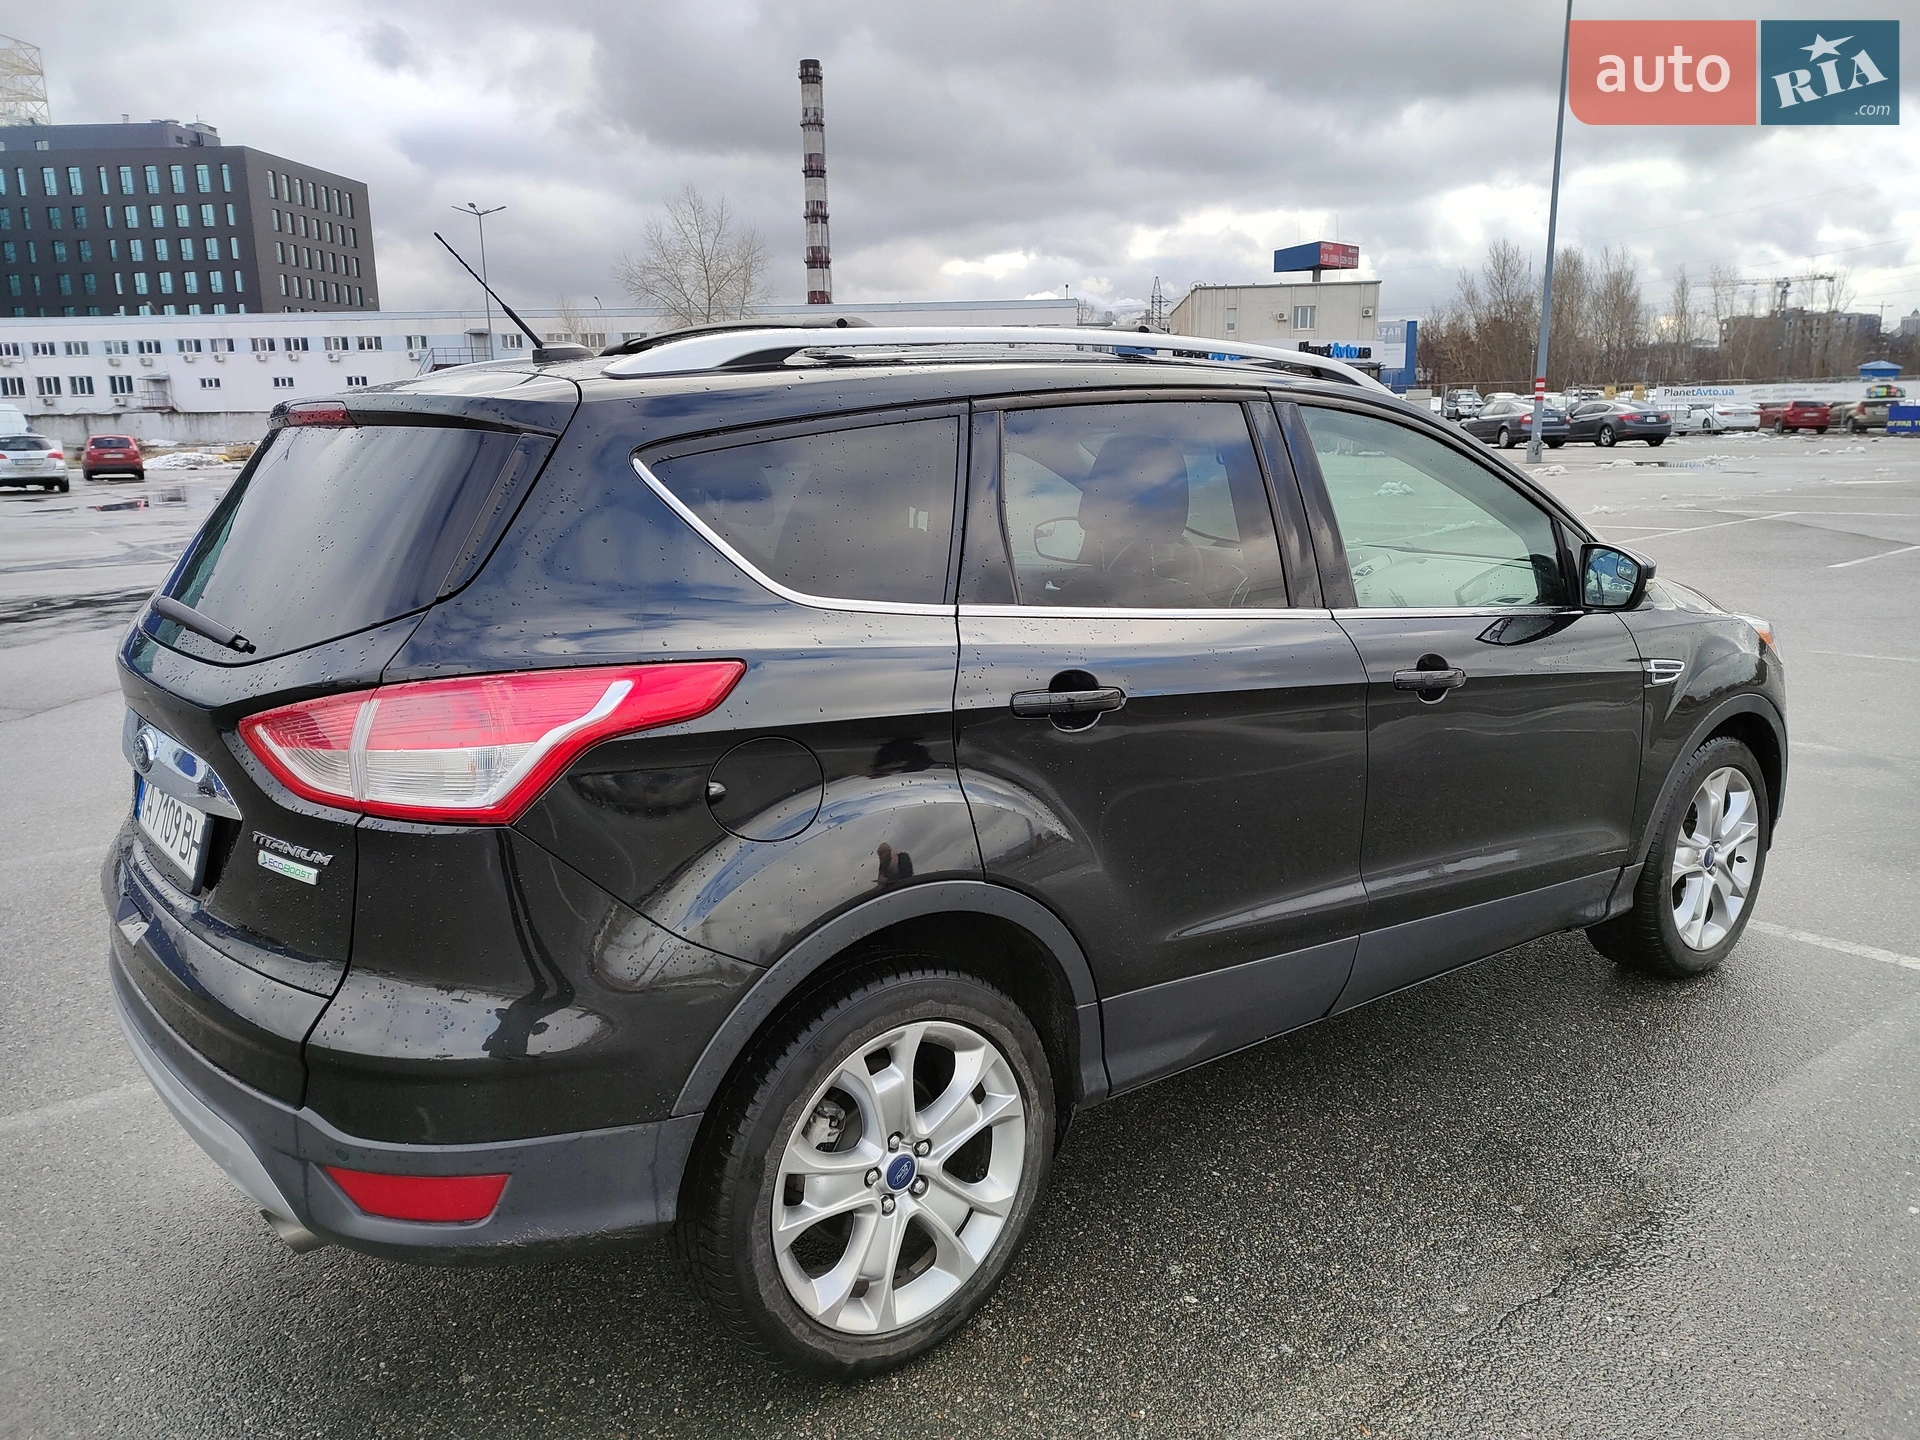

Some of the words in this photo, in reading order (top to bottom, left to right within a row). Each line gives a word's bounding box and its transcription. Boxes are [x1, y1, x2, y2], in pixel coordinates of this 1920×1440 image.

[1664, 387, 1735, 396] PlanetAvto.ua
[153, 788, 182, 849] 7109
[252, 830, 335, 866] TITANIUM
[268, 858, 313, 879] ECOBOOST
